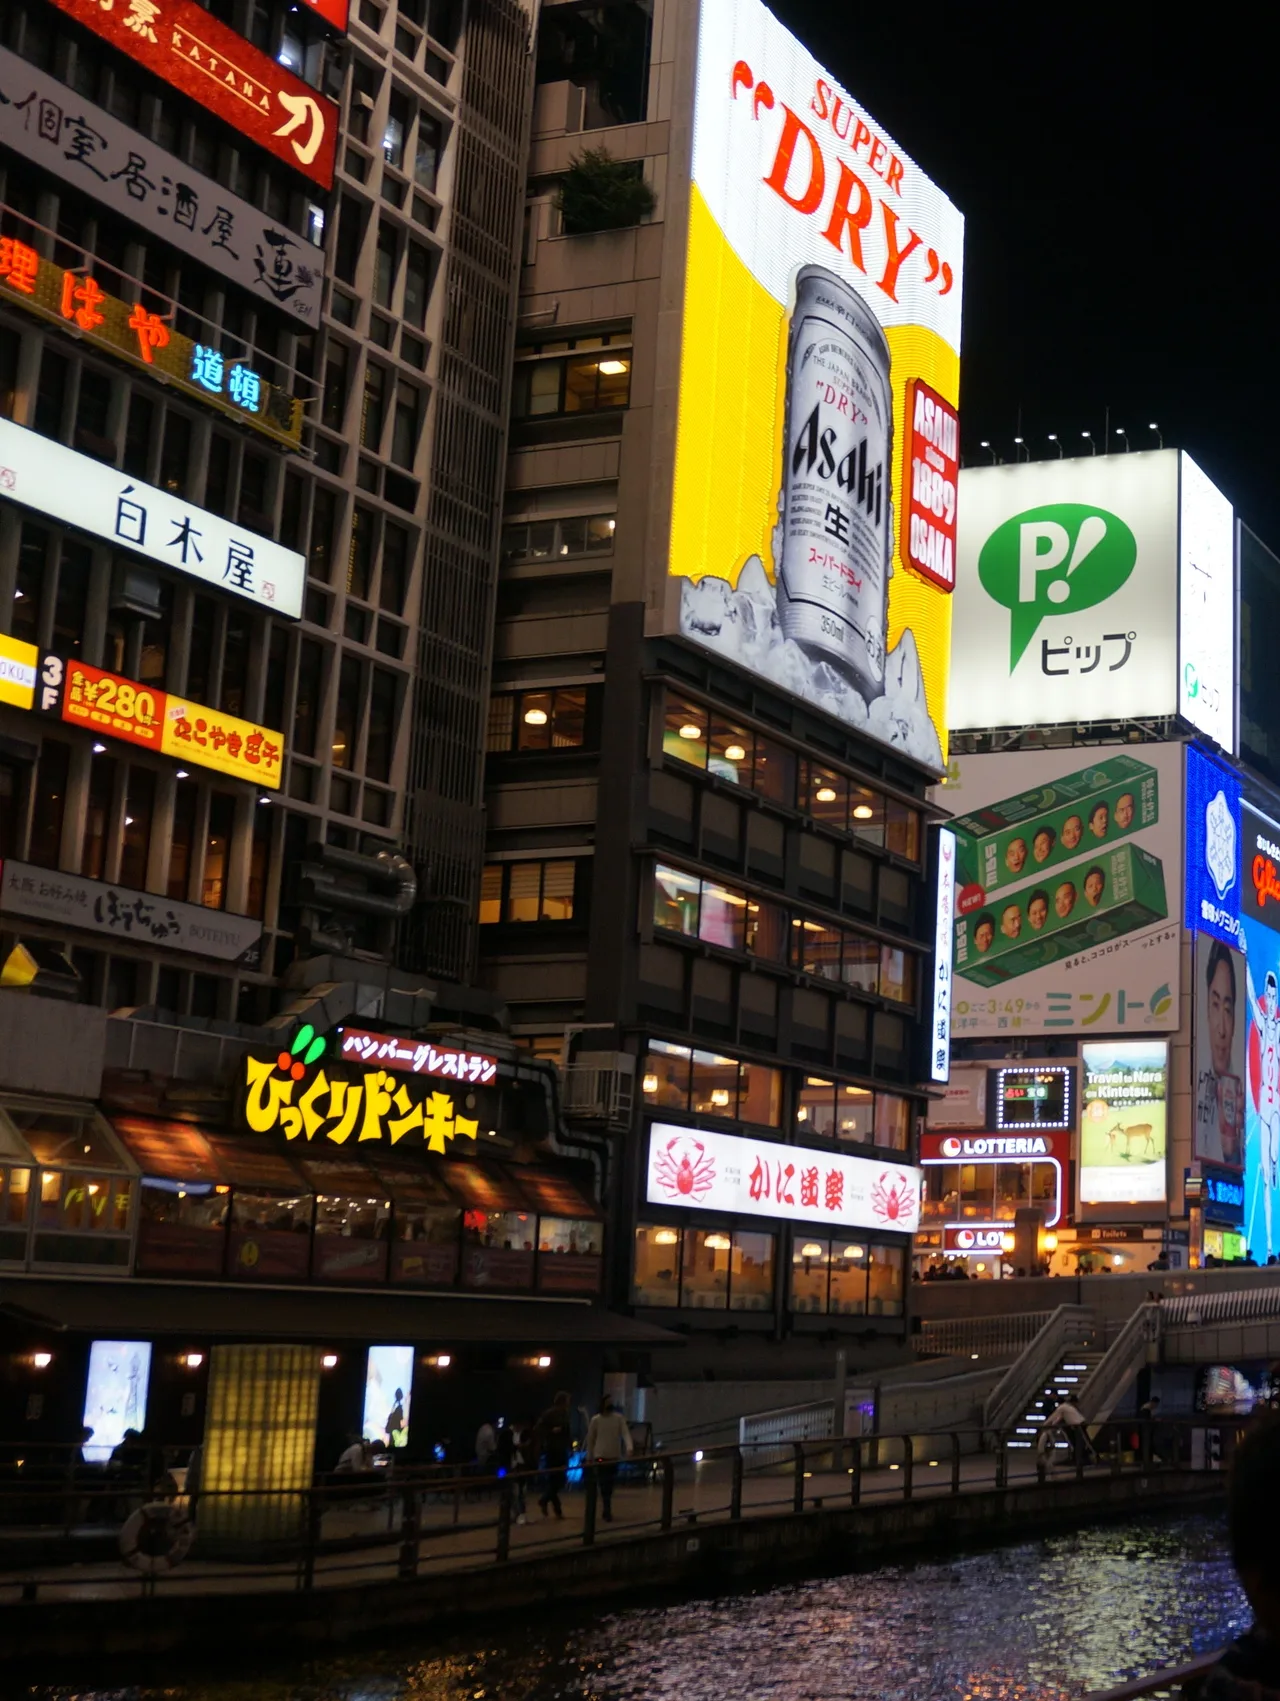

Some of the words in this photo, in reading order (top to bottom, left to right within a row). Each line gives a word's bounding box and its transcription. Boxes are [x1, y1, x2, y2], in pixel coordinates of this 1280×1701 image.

[171, 31, 270, 110] KATANA
[272, 90, 325, 165] 刀
[809, 78, 905, 199] SUPER
[813, 355, 827, 368] THE
[827, 358, 851, 383] JAPAN
[913, 389, 957, 463] ASAHI
[791, 401, 884, 530] Asahi
[912, 456, 956, 526] 1889
[114, 484, 256, 594] 白木屋
[824, 503, 850, 547] 生
[910, 512, 953, 584] OSAKA
[808, 547, 863, 594] スーパードライ
[1041, 630, 1138, 677] ピップ
[41, 654, 64, 711] 3F
[83, 676, 156, 724] ¥280
[1043, 988, 1145, 1027] ミント
[342, 1034, 497, 1083] ハンバーグレストラン
[1086, 1071, 1123, 1084] Travel
[1124, 1074, 1133, 1083] to
[1133, 1070, 1163, 1083] Nara
[245, 1055, 479, 1155] びっくりドンキー
[1098, 1085, 1152, 1098] Kintetsu.
[964, 1138, 1047, 1155] LOTTERIA
[748, 1155, 845, 1212] かに道楽
